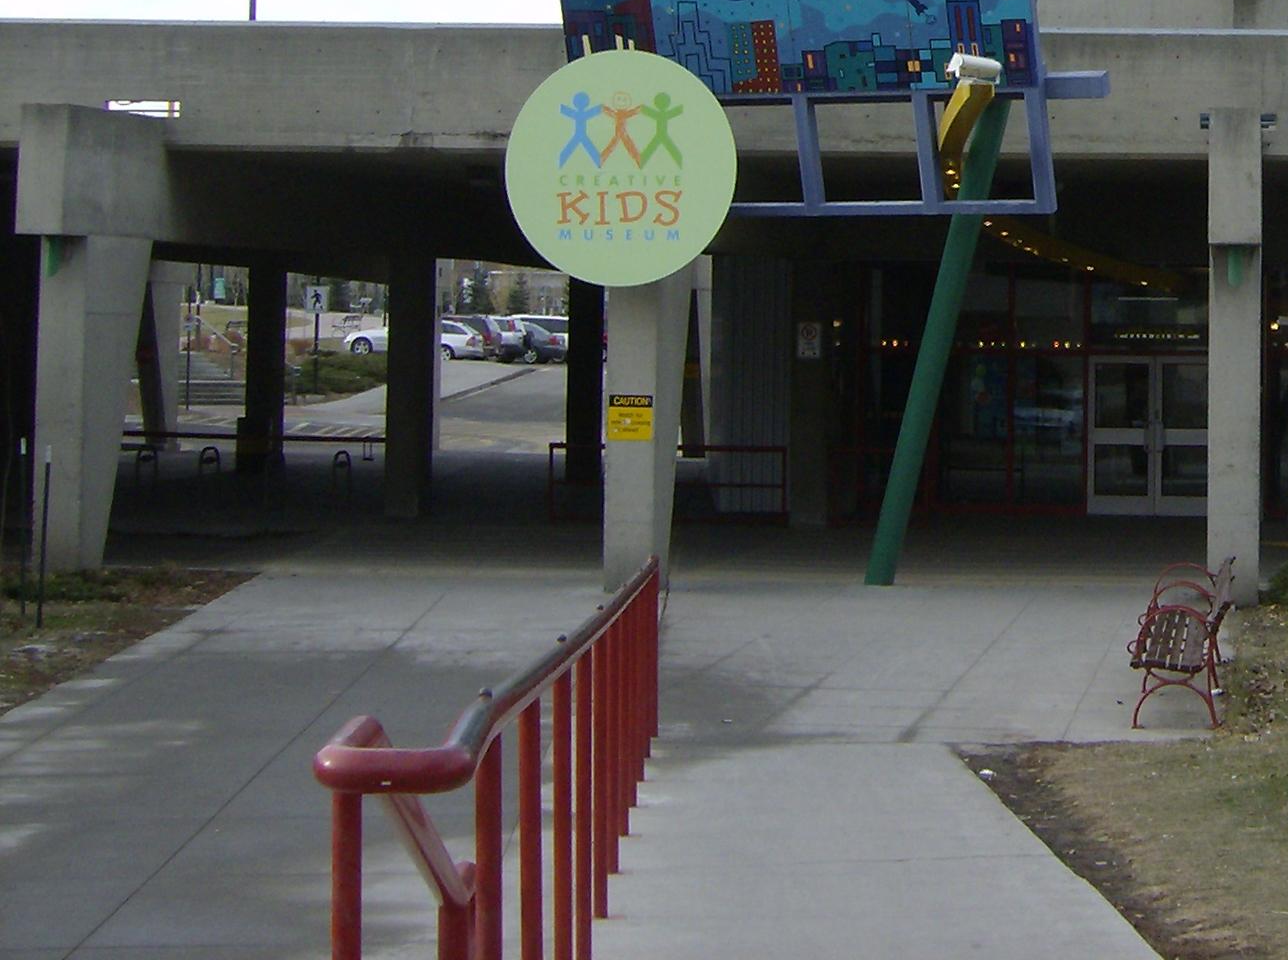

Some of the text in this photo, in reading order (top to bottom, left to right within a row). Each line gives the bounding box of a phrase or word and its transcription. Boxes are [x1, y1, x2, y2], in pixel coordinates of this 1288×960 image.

[559, 174, 681, 186] CREATIVE
[556, 190, 683, 227] KIDS
[558, 229, 680, 241] MUSEUM
[613, 396, 648, 406] CAUTION
